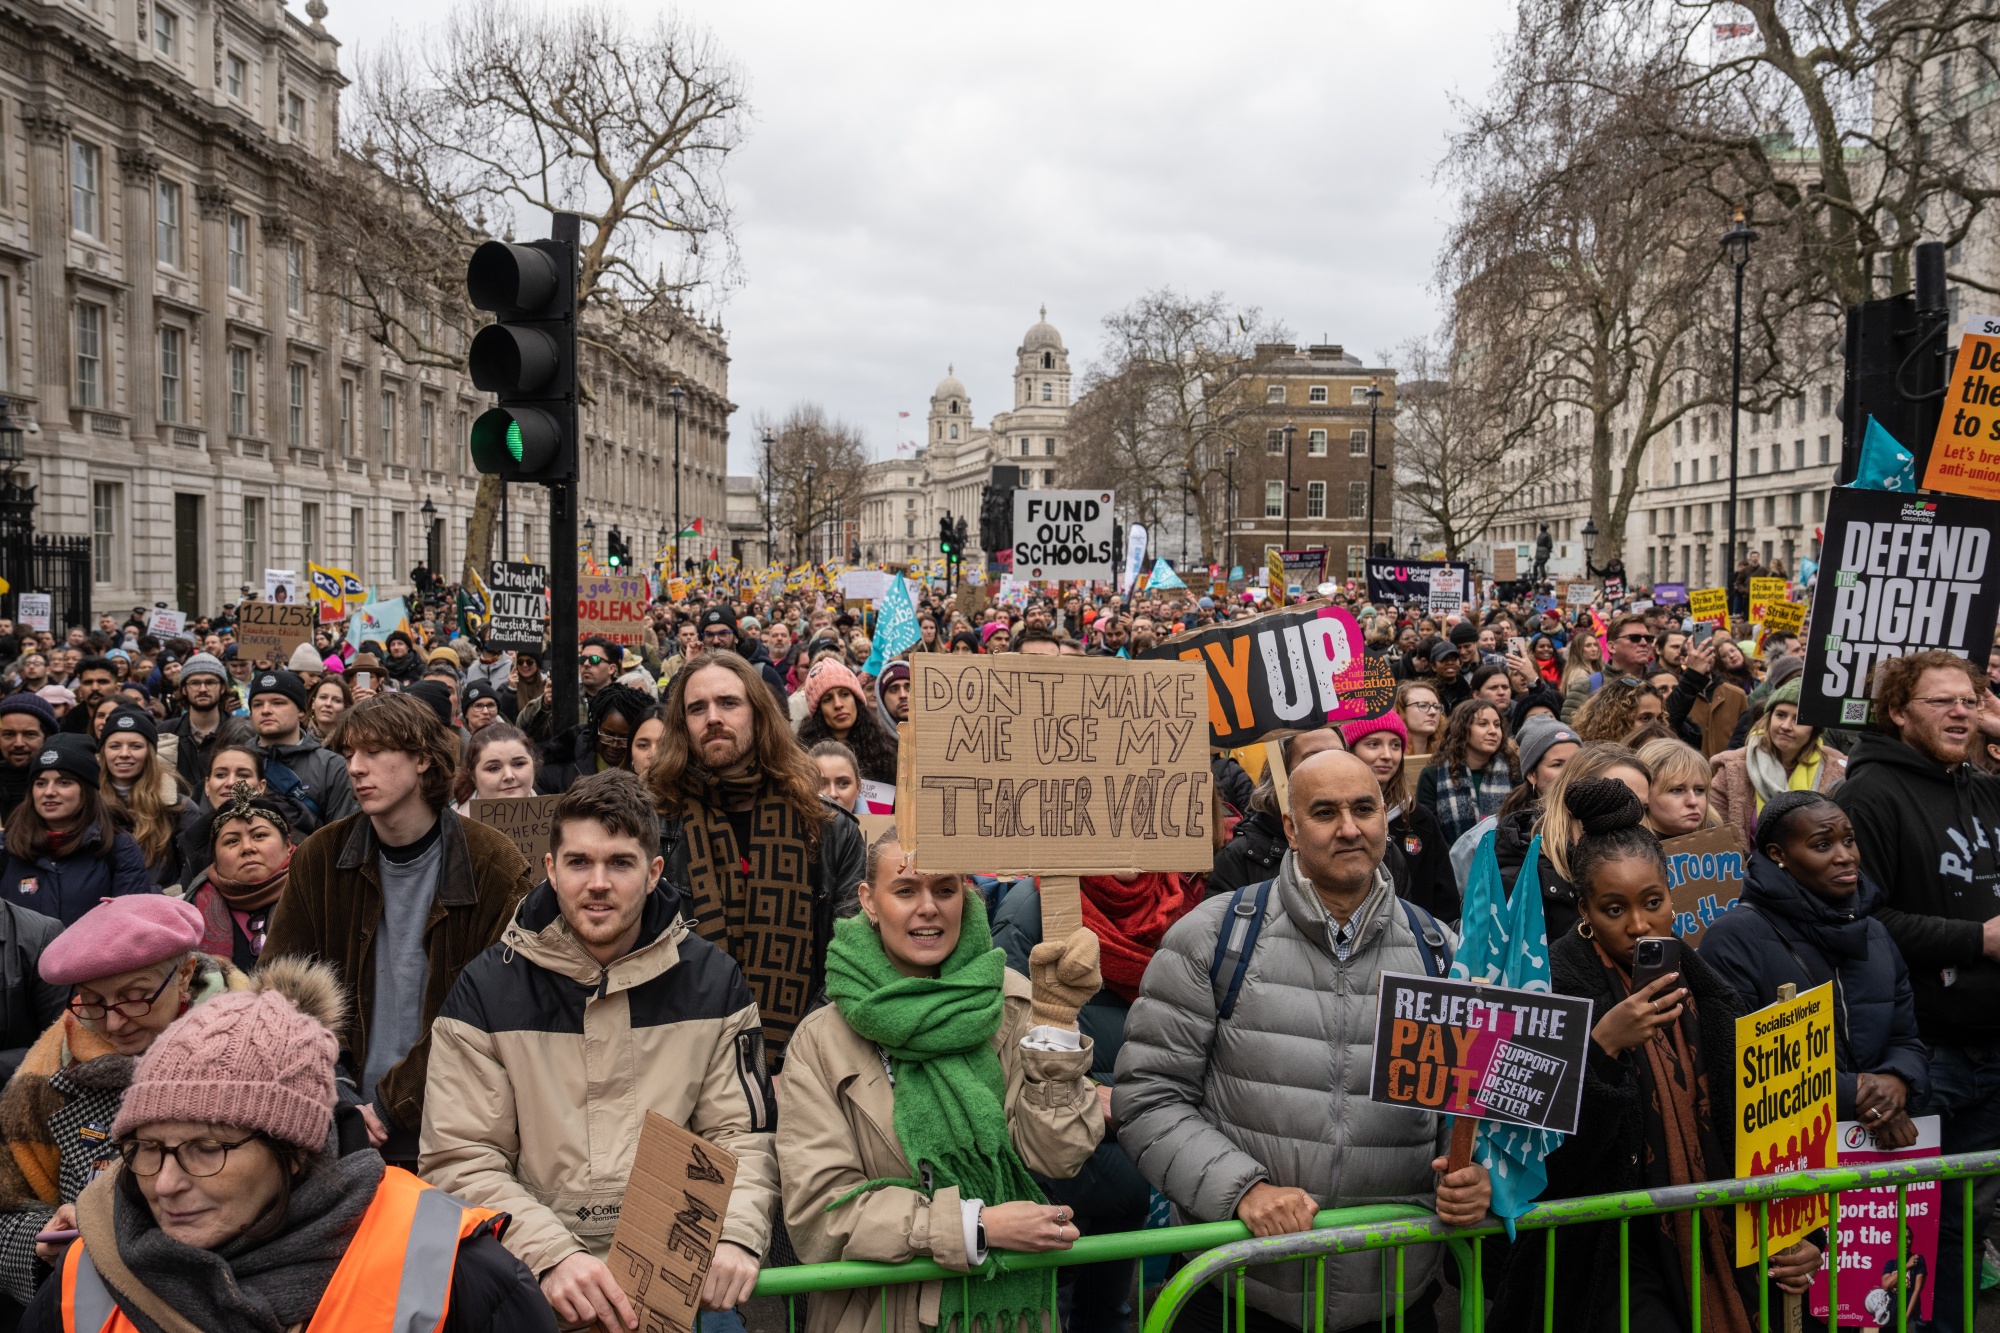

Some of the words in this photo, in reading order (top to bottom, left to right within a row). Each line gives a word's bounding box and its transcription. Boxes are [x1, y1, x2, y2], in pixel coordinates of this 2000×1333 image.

[1953, 408, 1981, 437] to
[1944, 444, 1974, 465] Let's
[1028, 500, 1100, 522] FUND
[1901, 508, 1936, 518] peoples
[1903, 502, 1915, 510] the
[1902, 515, 1933, 524] assembly
[1037, 524, 1086, 544] OUR
[1016, 541, 1111, 565] SCHOOLS
[1841, 521, 1991, 581] DEFEND
[493, 562, 544, 594] Straight
[1372, 565, 1407, 582] UCU
[1836, 572, 1856, 586] THE
[345, 578, 363, 591] CS
[586, 579, 612, 599] got
[621, 581, 638, 597] 99
[1752, 583, 1772, 591] Strike
[1774, 583, 1784, 591] for
[493, 592, 541, 618] OUTTA
[1431, 601, 1459, 609] STRIKE
[1692, 596, 1712, 606] Strike
[1714, 593, 1724, 603] for
[1751, 592, 1784, 601] education
[578, 600, 644, 622] OBLEMS
[1694, 603, 1726, 613] education
[1767, 606, 1789, 620] Strike
[1790, 611, 1802, 623] for
[1831, 577, 1981, 647] RIGHT
[242, 625, 274, 635] teachers
[279, 627, 300, 636] think
[491, 616, 508, 629] Glue
[1764, 618, 1799, 633] education
[242, 634, 281, 645] ENOUGH
[491, 628, 513, 641] Pencils
[1827, 635, 1841, 650] TO
[1178, 635, 1255, 737] AY
[1258, 617, 1351, 721] UP
[1348, 669, 1379, 677] national
[1334, 677, 1396, 691] education
[1354, 689, 1377, 697] union
[1081, 671, 1197, 719] MAKE
[946, 715, 1012, 763] ME
[1034, 714, 1098, 765] USE
[1116, 720, 1193, 765] MY
[861, 791, 877, 799] CISM
[866, 784, 876, 792] UP
[480, 800, 555, 824] PAYING
[921, 776, 1096, 838] TEACHER
[1104, 769, 1208, 840] VOICE
[497, 822, 550, 838] CHERS
[1406, 843, 1415, 852] UP
[1394, 987, 1504, 1032] REJECT
[1511, 1004, 1567, 1041] THE
[1390, 1018, 1480, 1067] PAY
[1496, 1043, 1560, 1076] SUPPORT
[1743, 1033, 1800, 1089] Strike
[1806, 1021, 1831, 1060] for
[1490, 1058, 1535, 1083] STAFF
[1388, 1058, 1479, 1110] CUT
[1484, 1073, 1546, 1106] DESERVE
[1479, 1090, 1530, 1118] BETTER
[1743, 1066, 1832, 1134] education
[591, 1205, 621, 1216] Colu
[1859, 1226, 1892, 1244] the
[660, 1189, 719, 1308] WET
